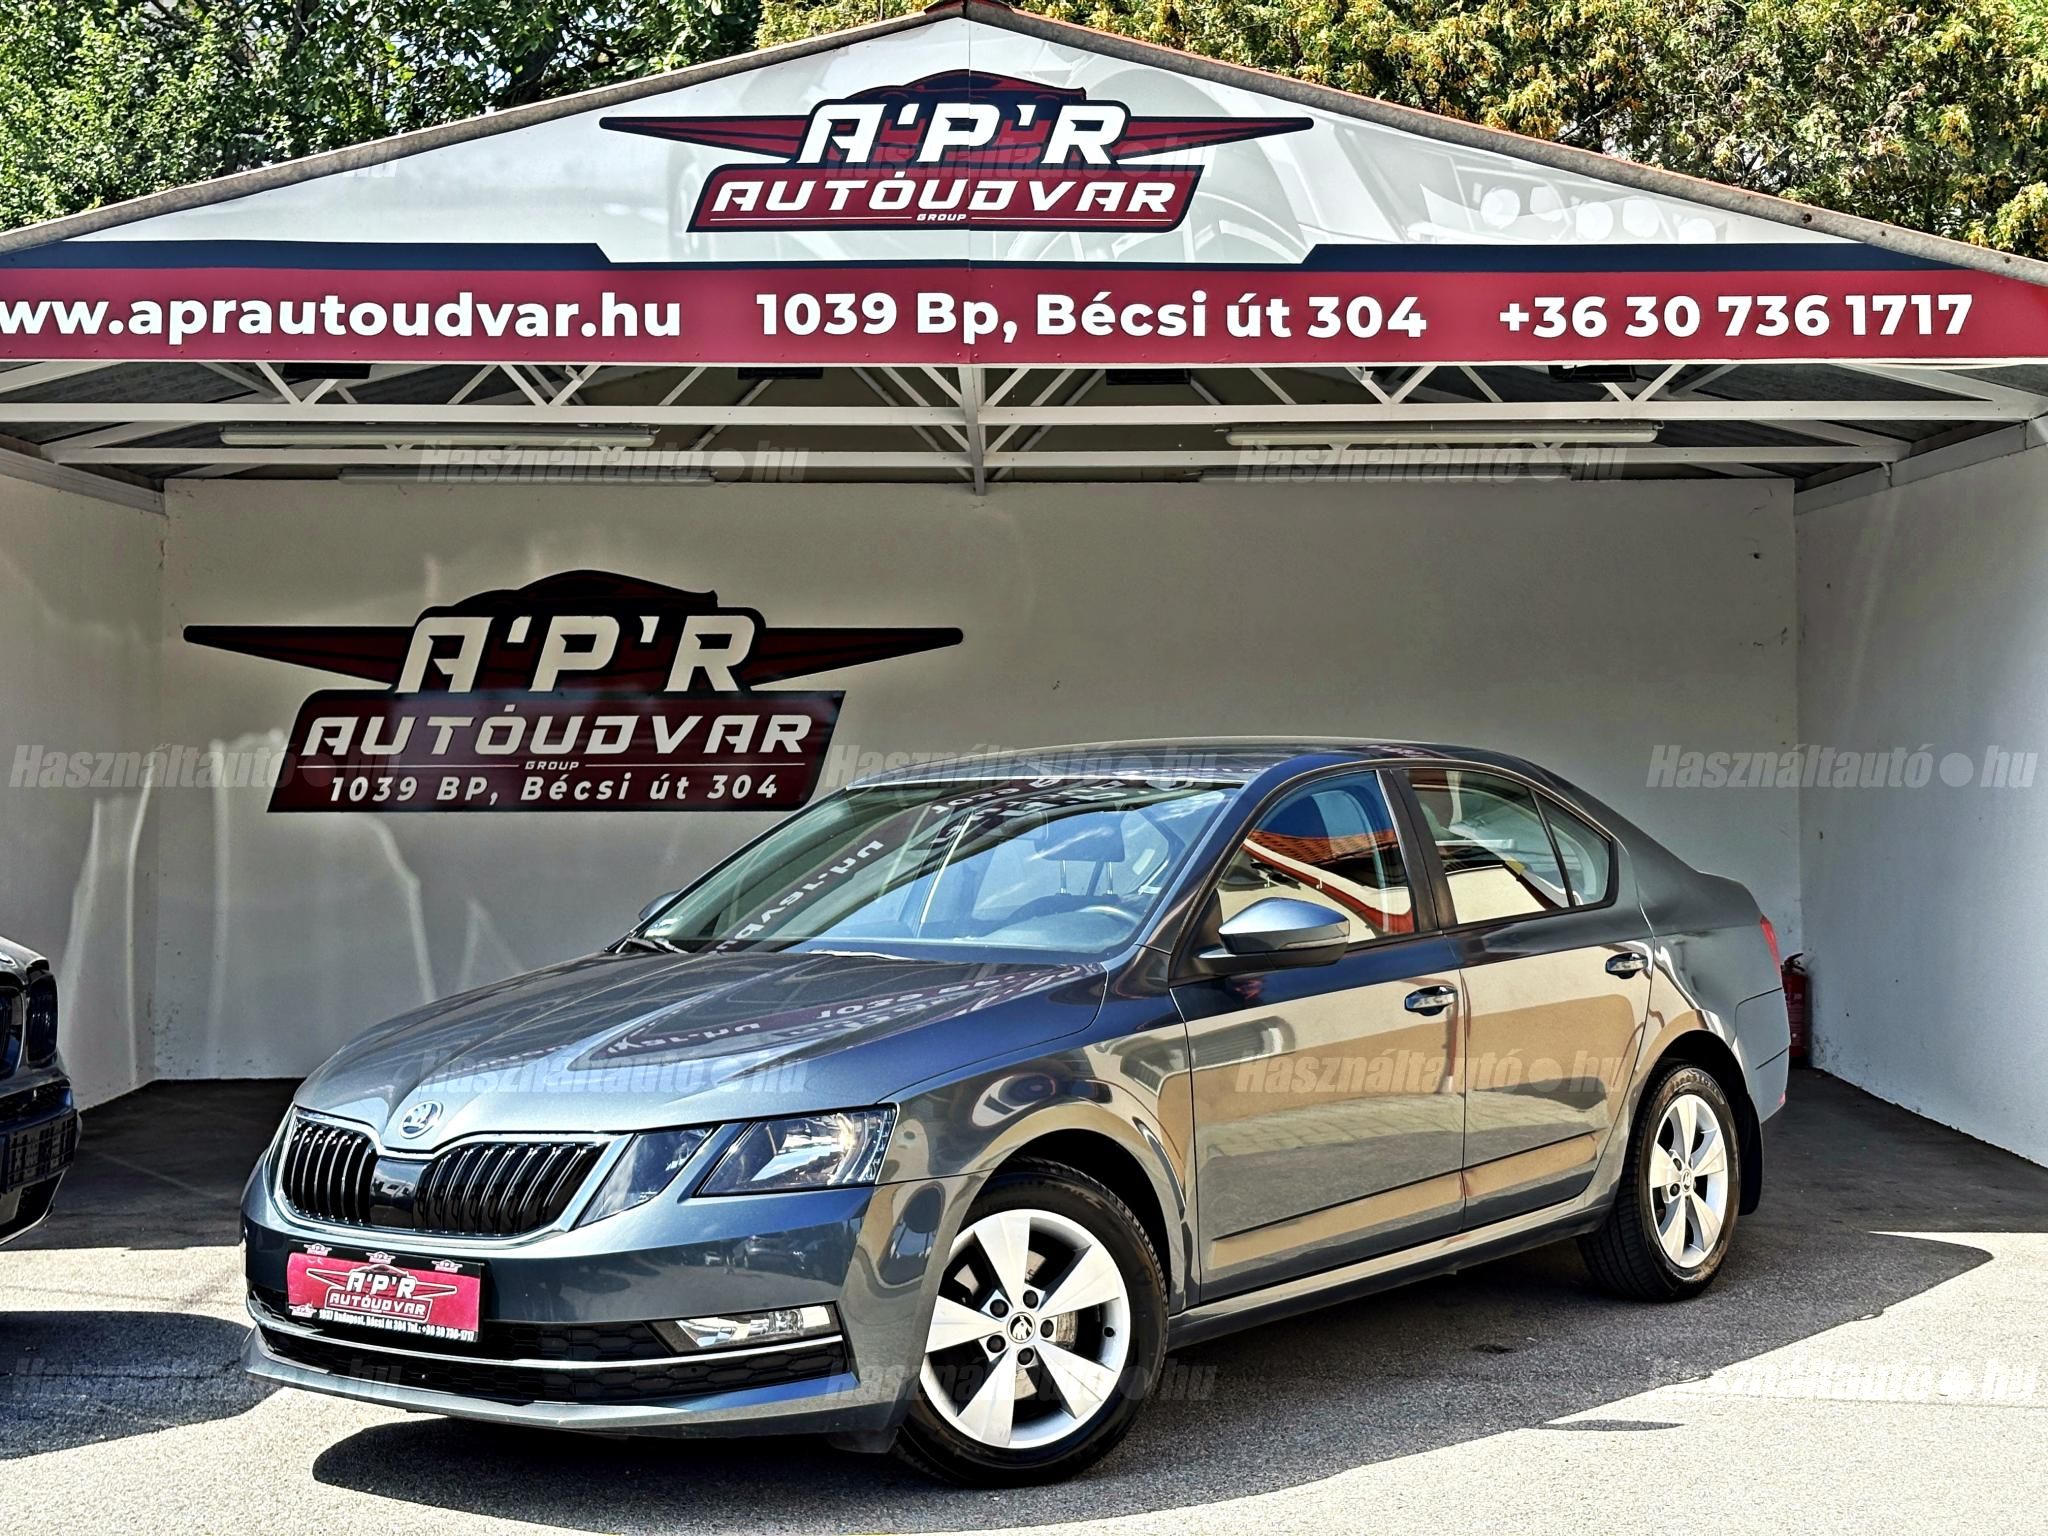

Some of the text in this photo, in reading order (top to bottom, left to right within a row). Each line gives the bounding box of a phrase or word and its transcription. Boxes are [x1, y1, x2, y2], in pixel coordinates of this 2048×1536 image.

[711, 170, 1176, 213] AUTÓUDVAR
[916, 212, 967, 222] GROUP
[0, 292, 680, 345] ww.aprautoudvar.hu
[757, 290, 1427, 345] 1039 Bp, Bécsi út 304
[1500, 294, 1973, 338] +36 30 736 1717
[300, 703, 812, 756] AUTÓUDVAR
[524, 760, 580, 771] GROUP
[330, 772, 777, 806] 1039 BP, Bécsi út 304
